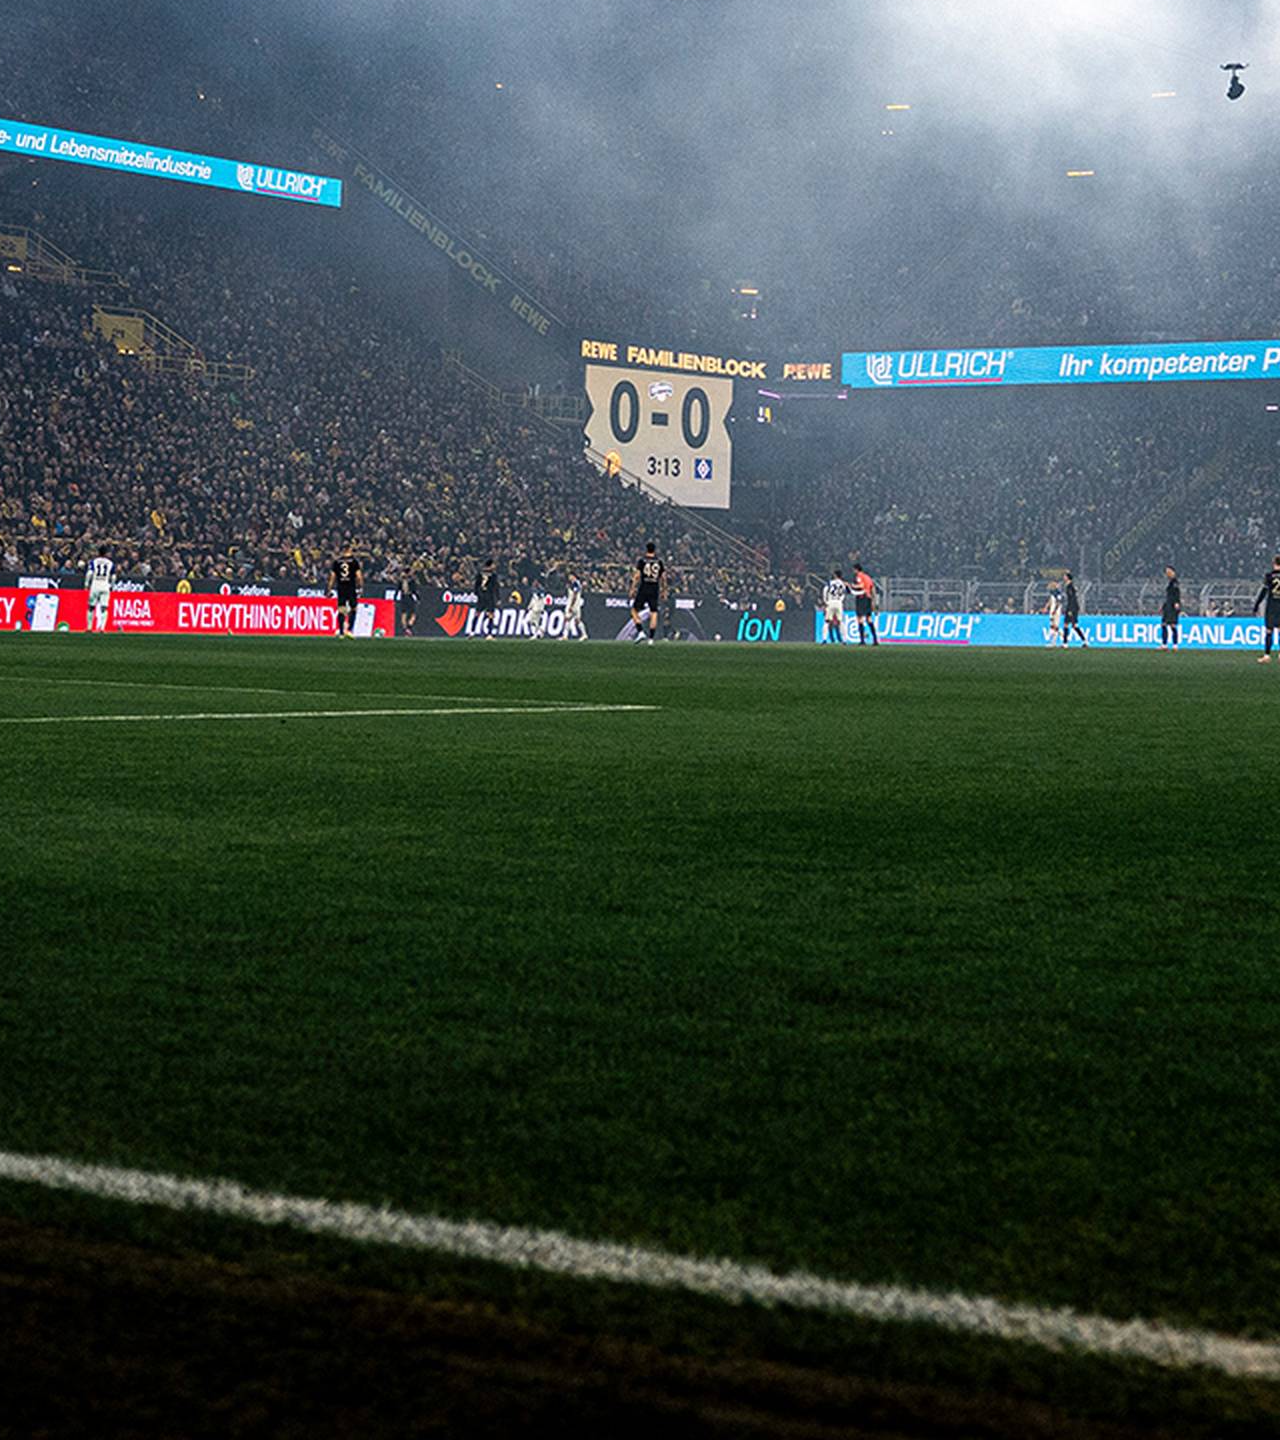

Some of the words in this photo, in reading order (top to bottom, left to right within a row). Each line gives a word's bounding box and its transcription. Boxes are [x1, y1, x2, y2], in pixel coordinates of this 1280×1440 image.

[15, 132, 46, 151] und
[50, 134, 212, 179] Lebensmittelindustrie
[256, 164, 321, 196] ULLRICH
[353, 163, 502, 293] FAMILIENBLOCK
[510, 294, 551, 336] REWE
[581, 340, 618, 361] REWE
[627, 346, 766, 379] FAMILIENBLOCK
[898, 350, 1007, 378] ULLRICH
[1059, 353, 1092, 376] Ihr
[1098, 346, 1256, 381] kompetenter
[647, 456, 681, 477] 3:13
[96, 564, 108, 577] 11
[340, 564, 349, 578] 3
[642, 562, 660, 579] 49
[113, 599, 151, 619] NAGA
[178, 602, 282, 630] EVERYTHING
[285, 605, 341, 631] MONEY
